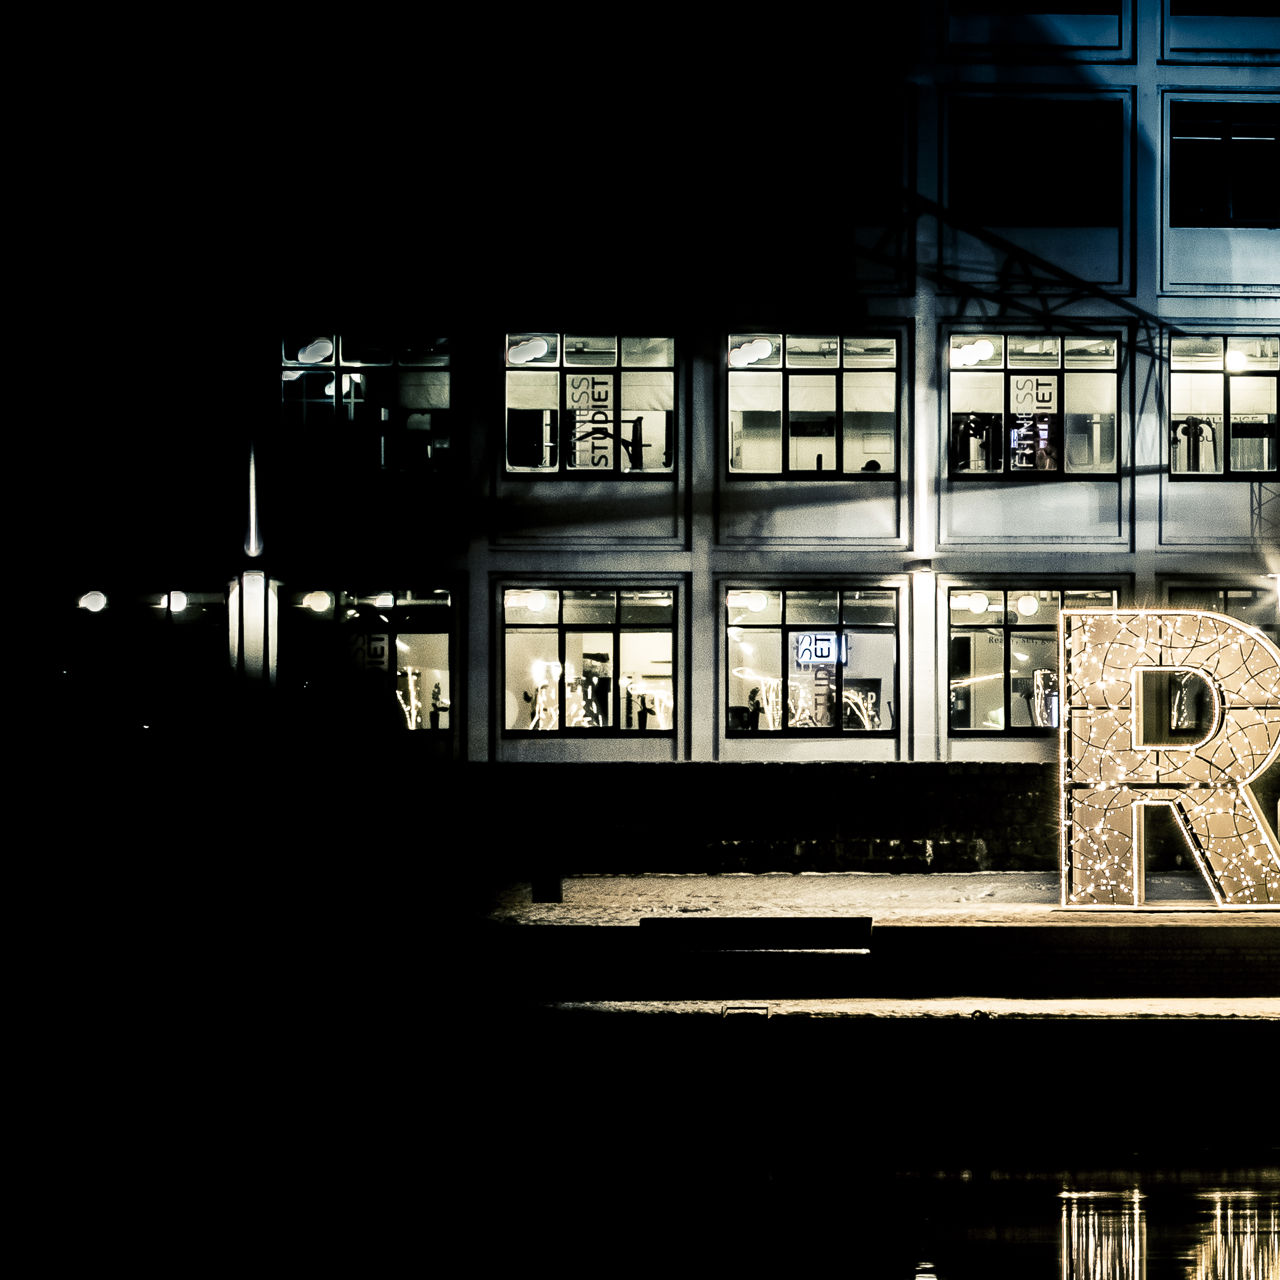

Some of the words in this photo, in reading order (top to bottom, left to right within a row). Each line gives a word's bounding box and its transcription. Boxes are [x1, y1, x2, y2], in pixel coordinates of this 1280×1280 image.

[591, 376, 609, 467] STUDIET
[1015, 378, 1034, 467] FITNESS
[814, 634, 832, 722] STUDET
